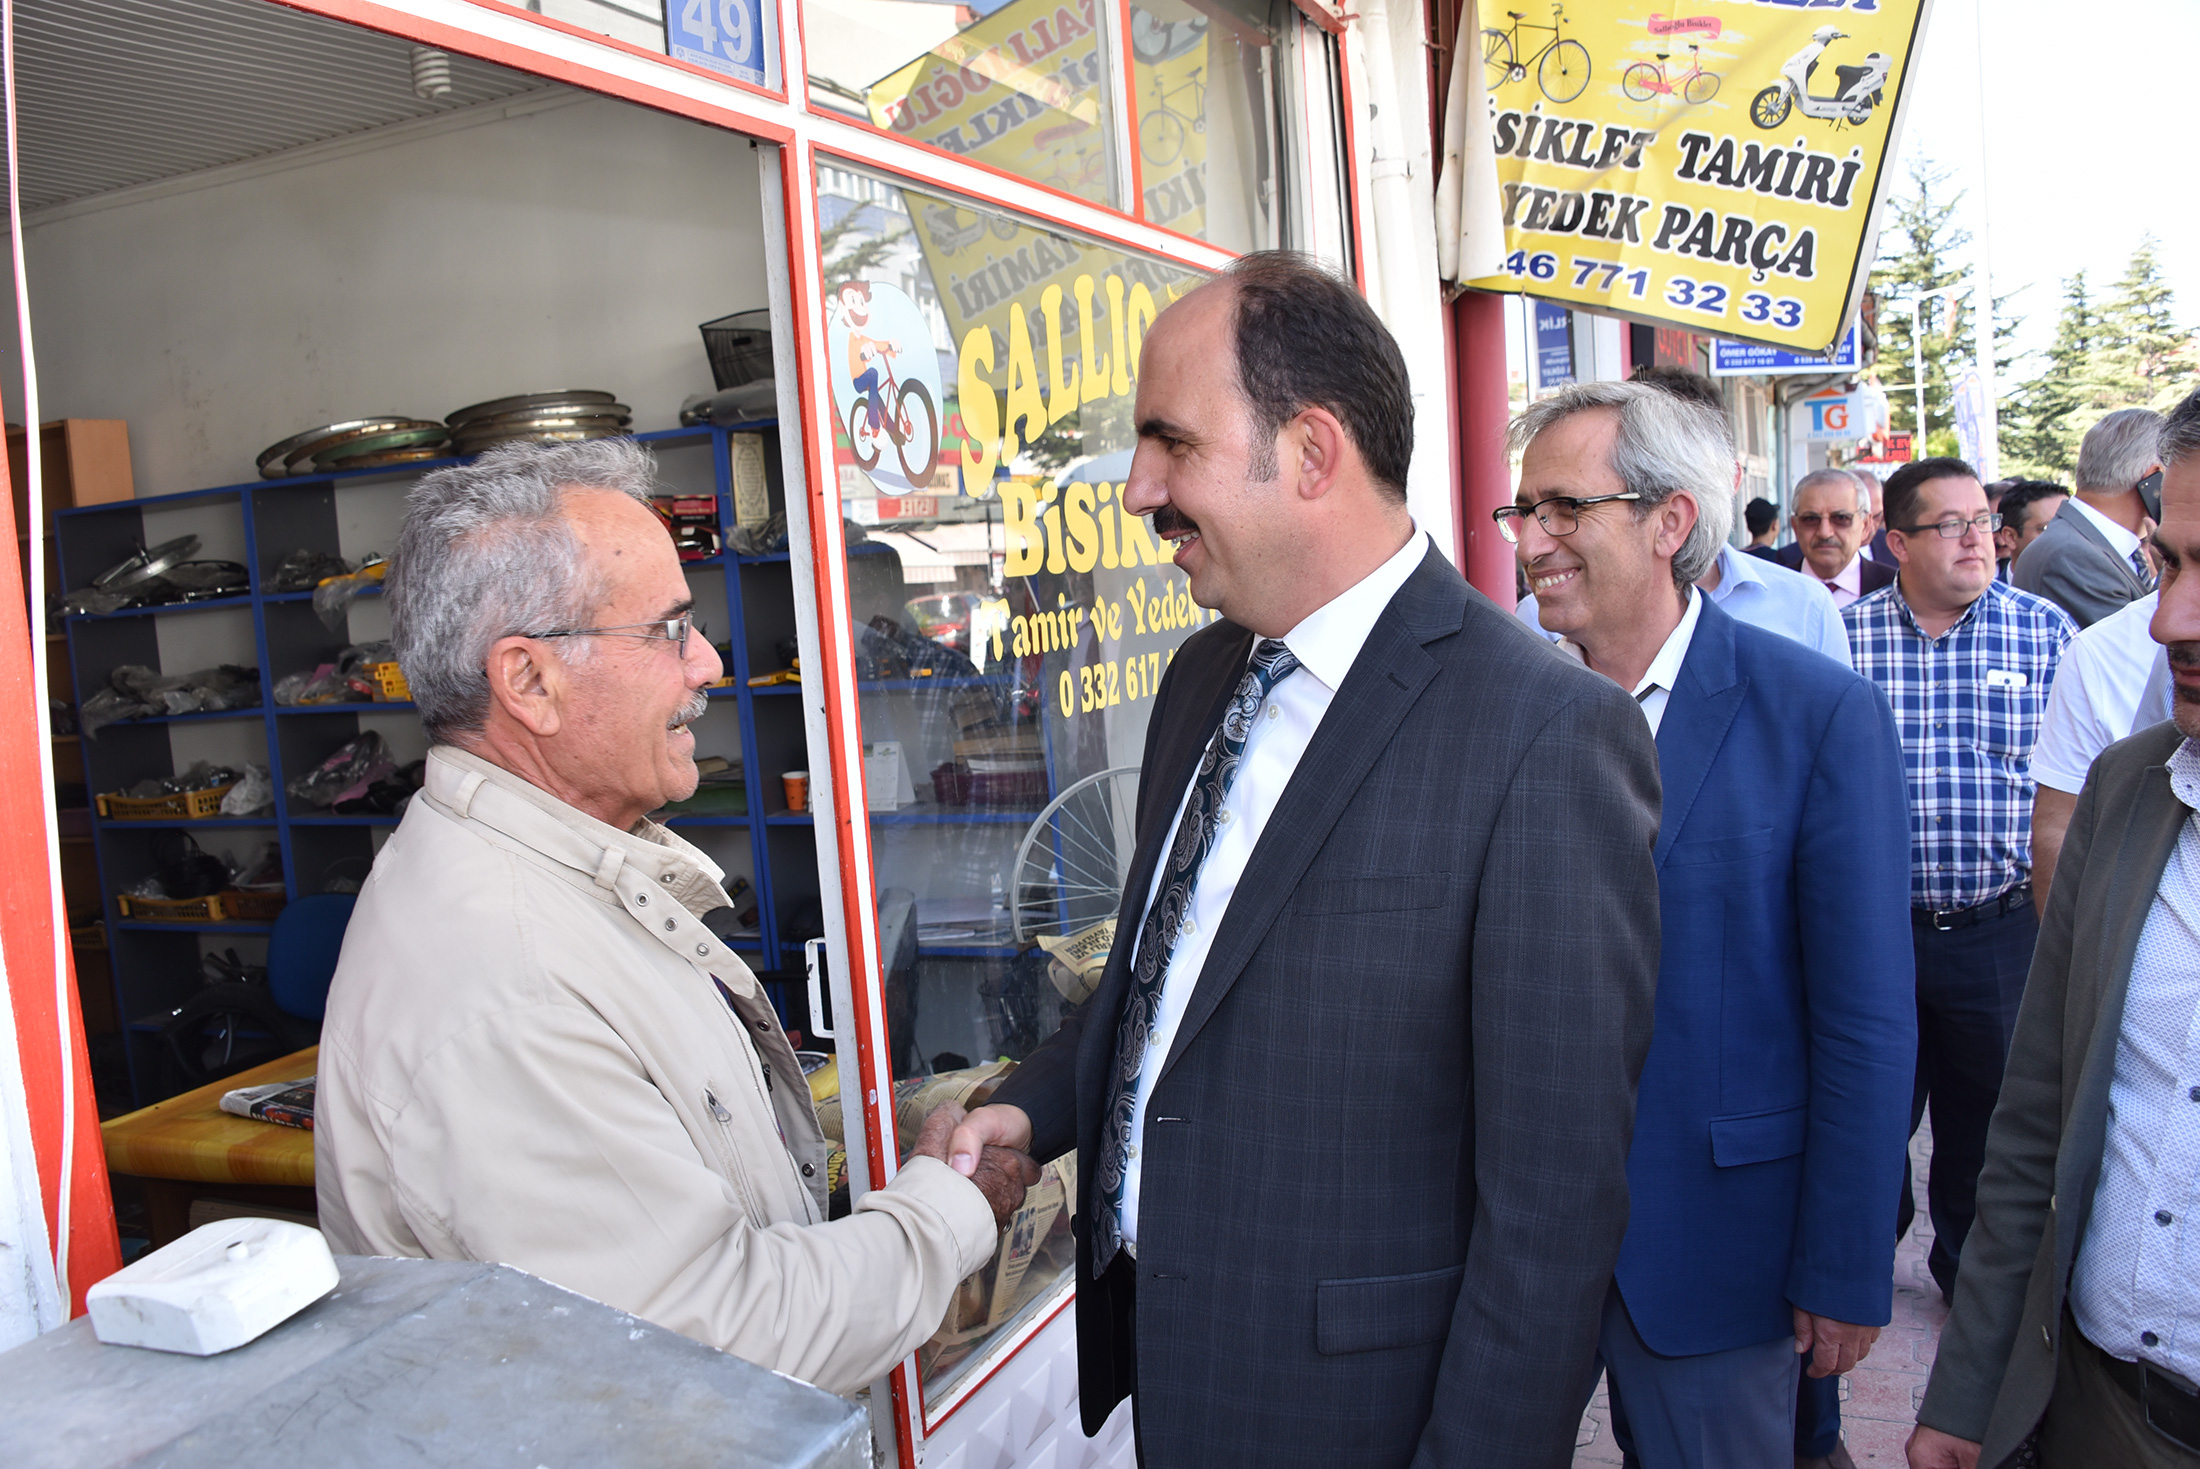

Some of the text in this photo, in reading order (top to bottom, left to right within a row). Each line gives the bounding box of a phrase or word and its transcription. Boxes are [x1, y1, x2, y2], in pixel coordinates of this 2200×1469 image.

[681, 0, 752, 63] 49
[1677, 132, 1861, 207] TAMİRİ
[1503, 184, 1814, 281] YEDEK PARÇA
[1506, 250, 1802, 327] 46 771 32 33
[958, 274, 1183, 498] SALLIO
[980, 577, 1202, 661] Tamir ve Yedek
[1059, 652, 1160, 718] 0 332 617
